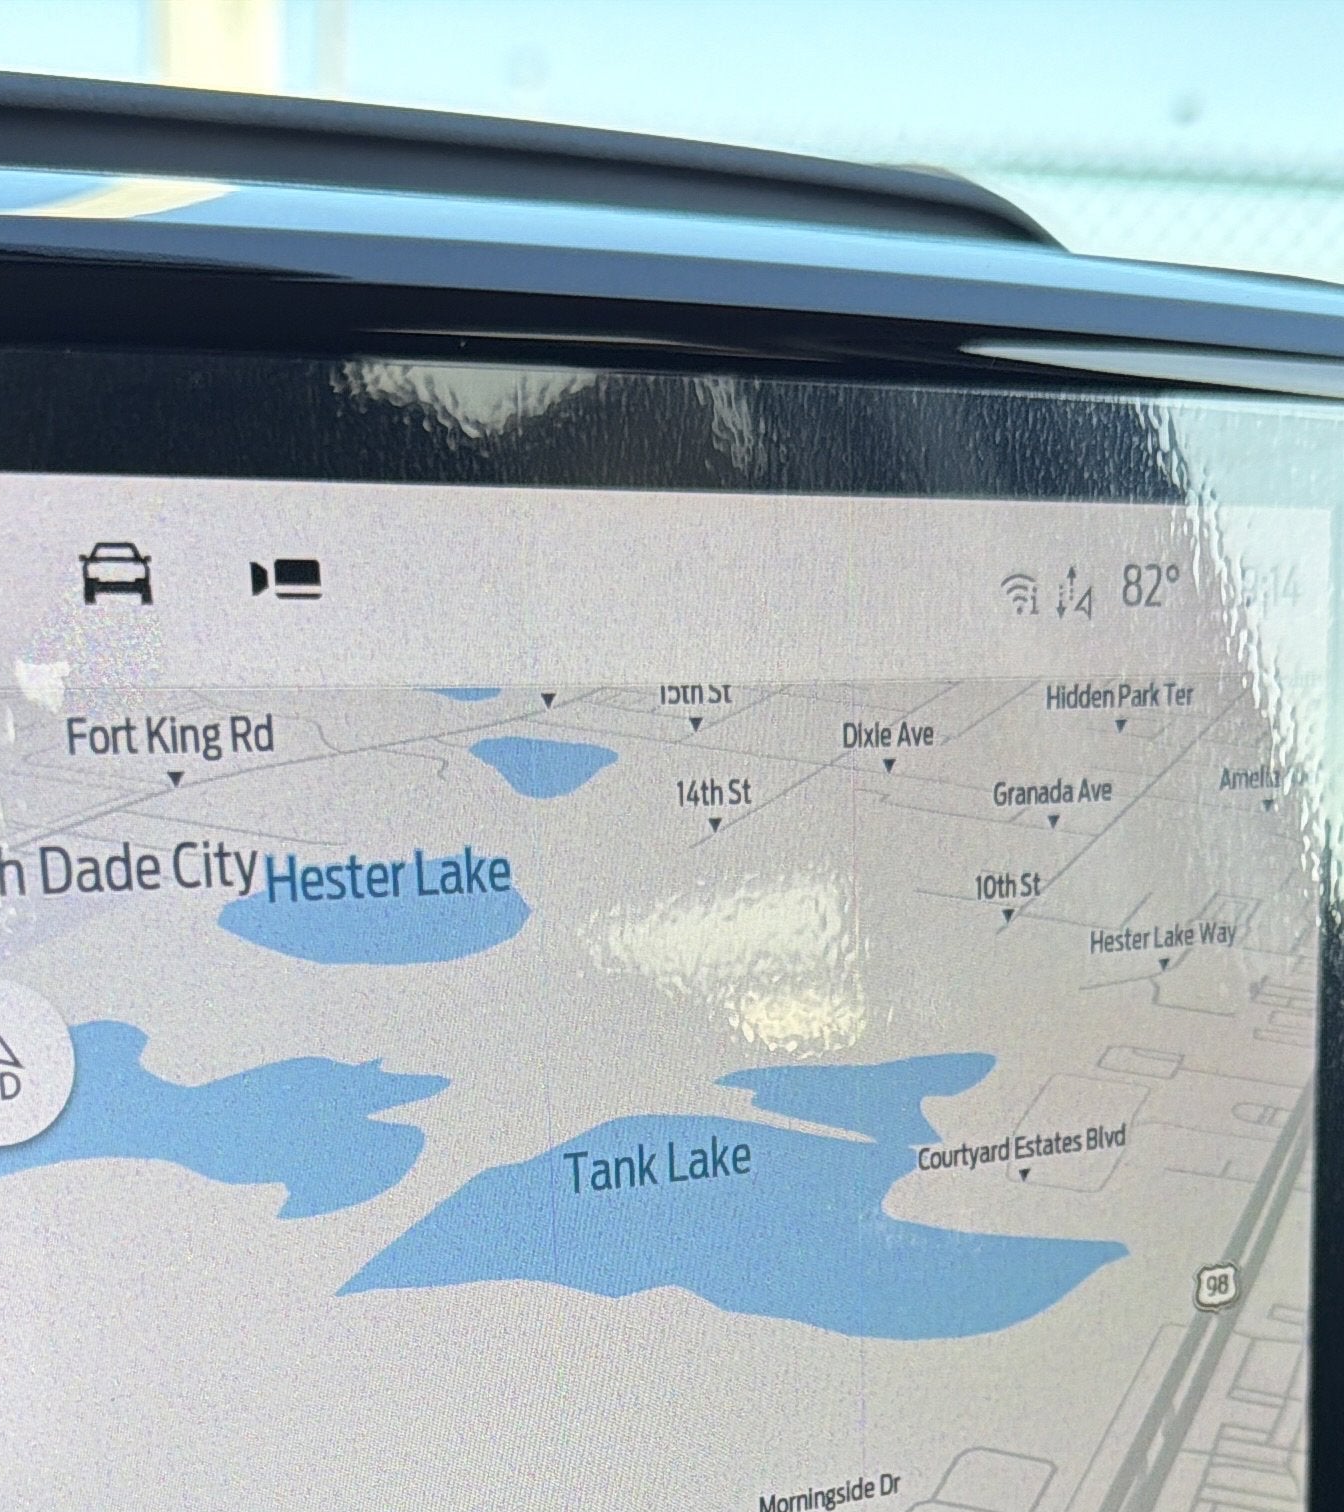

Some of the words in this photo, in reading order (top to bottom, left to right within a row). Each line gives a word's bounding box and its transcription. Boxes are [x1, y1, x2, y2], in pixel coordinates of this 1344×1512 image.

[1121, 563, 1181, 607] 82°
[660, 684, 704, 705] 15th
[708, 684, 733, 704] St
[1046, 684, 1115, 710] Hidden
[1118, 682, 1160, 708] Park
[1164, 681, 1194, 707] Ter
[66, 716, 136, 755] Fort
[146, 716, 221, 761] King
[231, 714, 275, 753] Rd
[842, 723, 893, 749] Dixie
[896, 723, 934, 747] Ave
[677, 777, 724, 807] 14th
[728, 778, 752, 805] St
[993, 781, 1072, 807] Granada
[1076, 779, 1113, 803] Ave
[39, 842, 160, 895] Dade
[172, 841, 259, 898] City
[265, 850, 402, 903] Hester
[415, 845, 512, 898] Lake
[975, 874, 1017, 900] 10th
[1020, 873, 1041, 899] St
[1090, 928, 1150, 955] Hester
[1155, 926, 1196, 951] Lake
[1198, 923, 1237, 951] Way
[917, 1135, 1010, 1173] Courtyard
[1014, 1130, 1083, 1161] Estates
[1086, 1123, 1127, 1153] Blvd
[562, 1149, 657, 1194] Tank
[667, 1137, 752, 1183] Lake
[1206, 1273, 1230, 1298] 98
[879, 1472, 901, 1498] Dr
